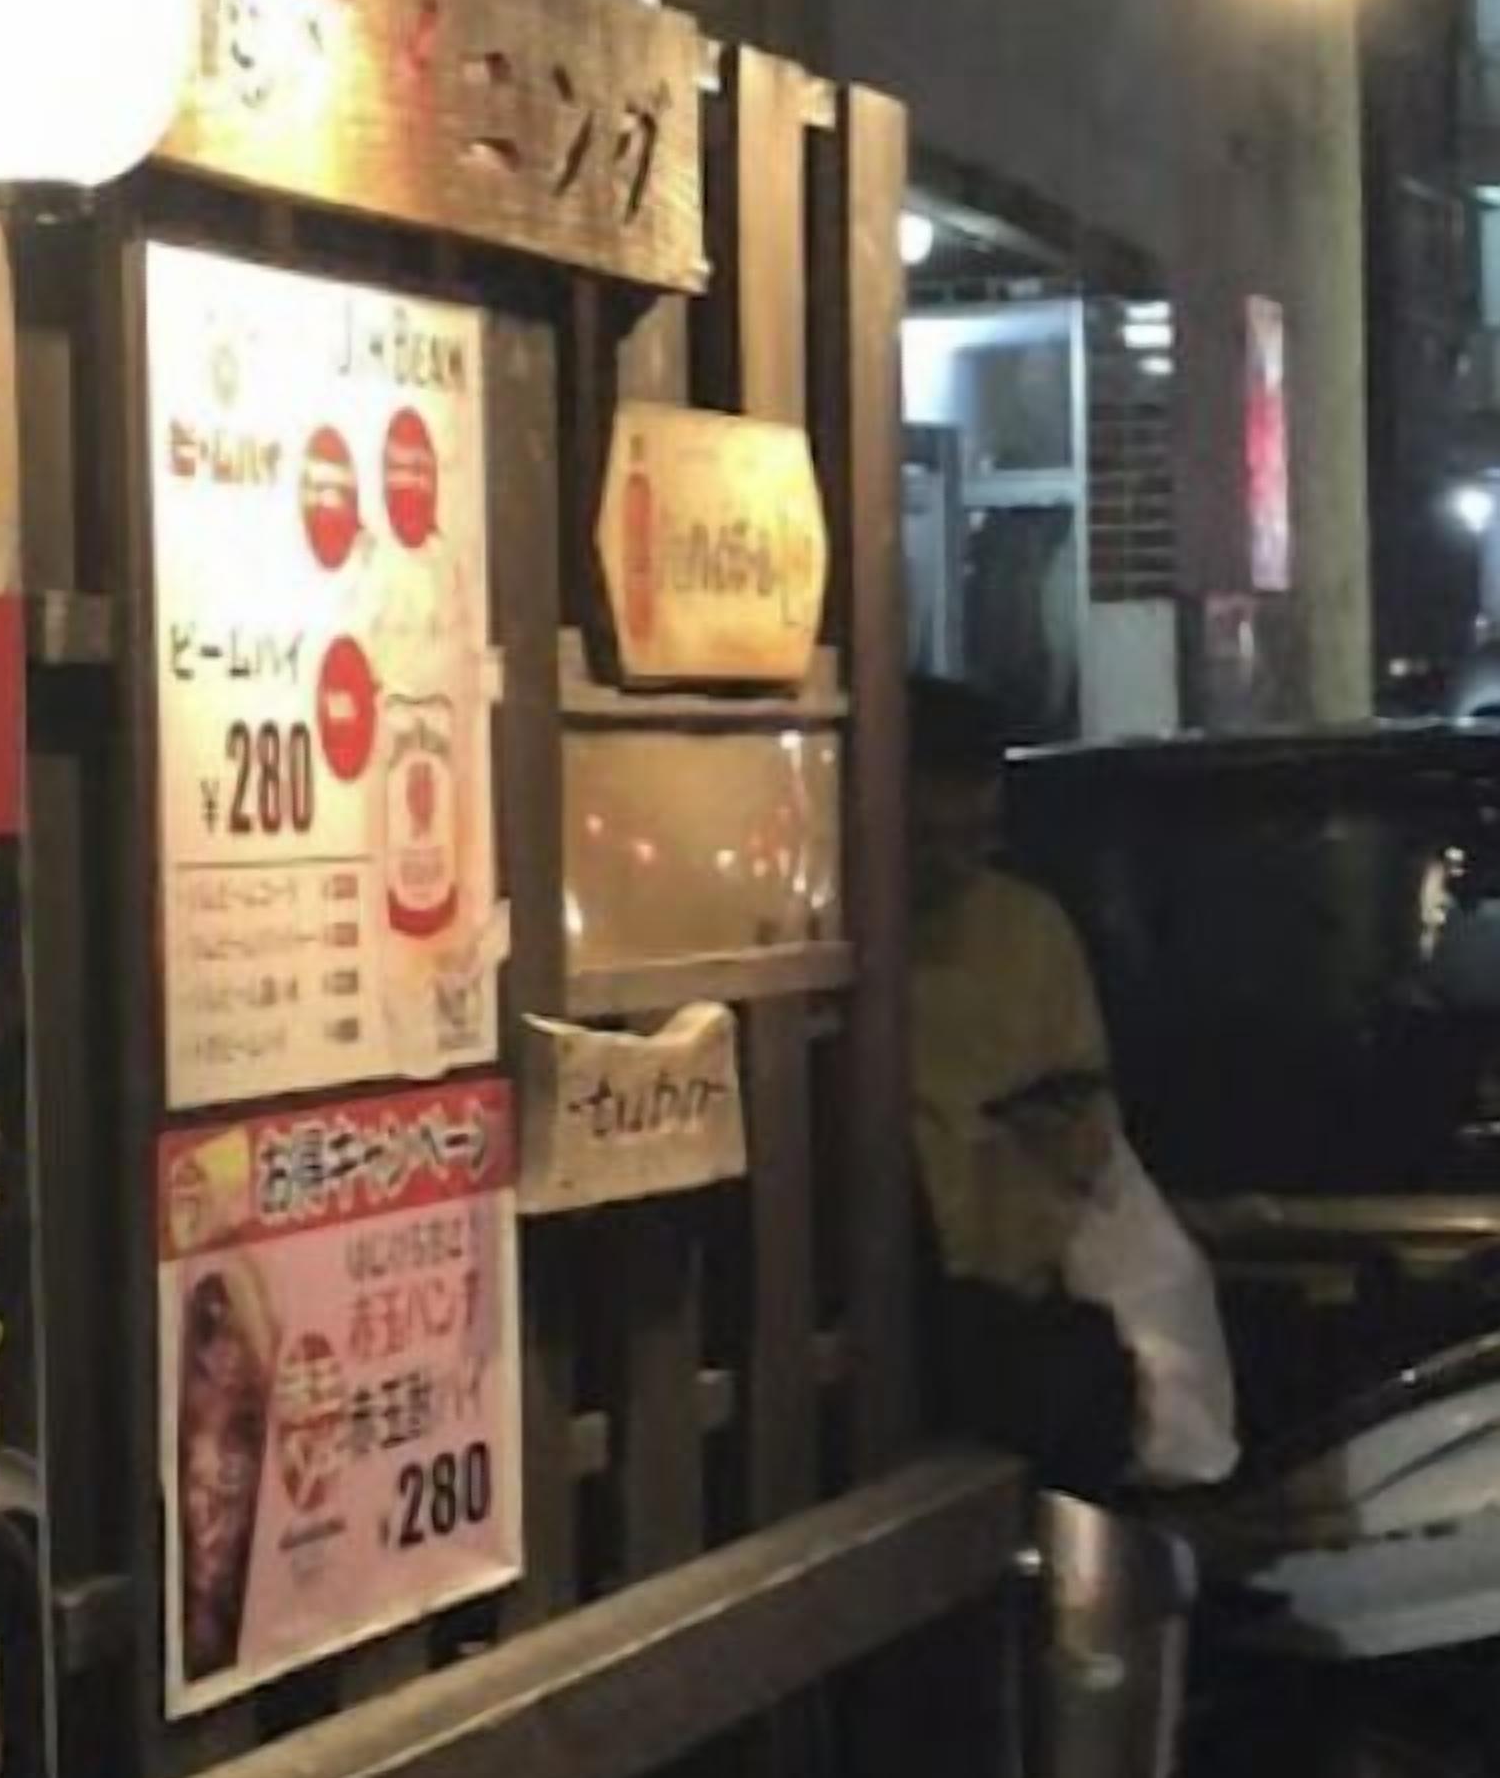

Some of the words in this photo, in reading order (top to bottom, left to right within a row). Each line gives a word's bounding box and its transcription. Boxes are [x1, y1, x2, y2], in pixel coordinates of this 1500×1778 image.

[168, 619, 305, 691] ビームハイ
[201, 717, 318, 835] ¥280
